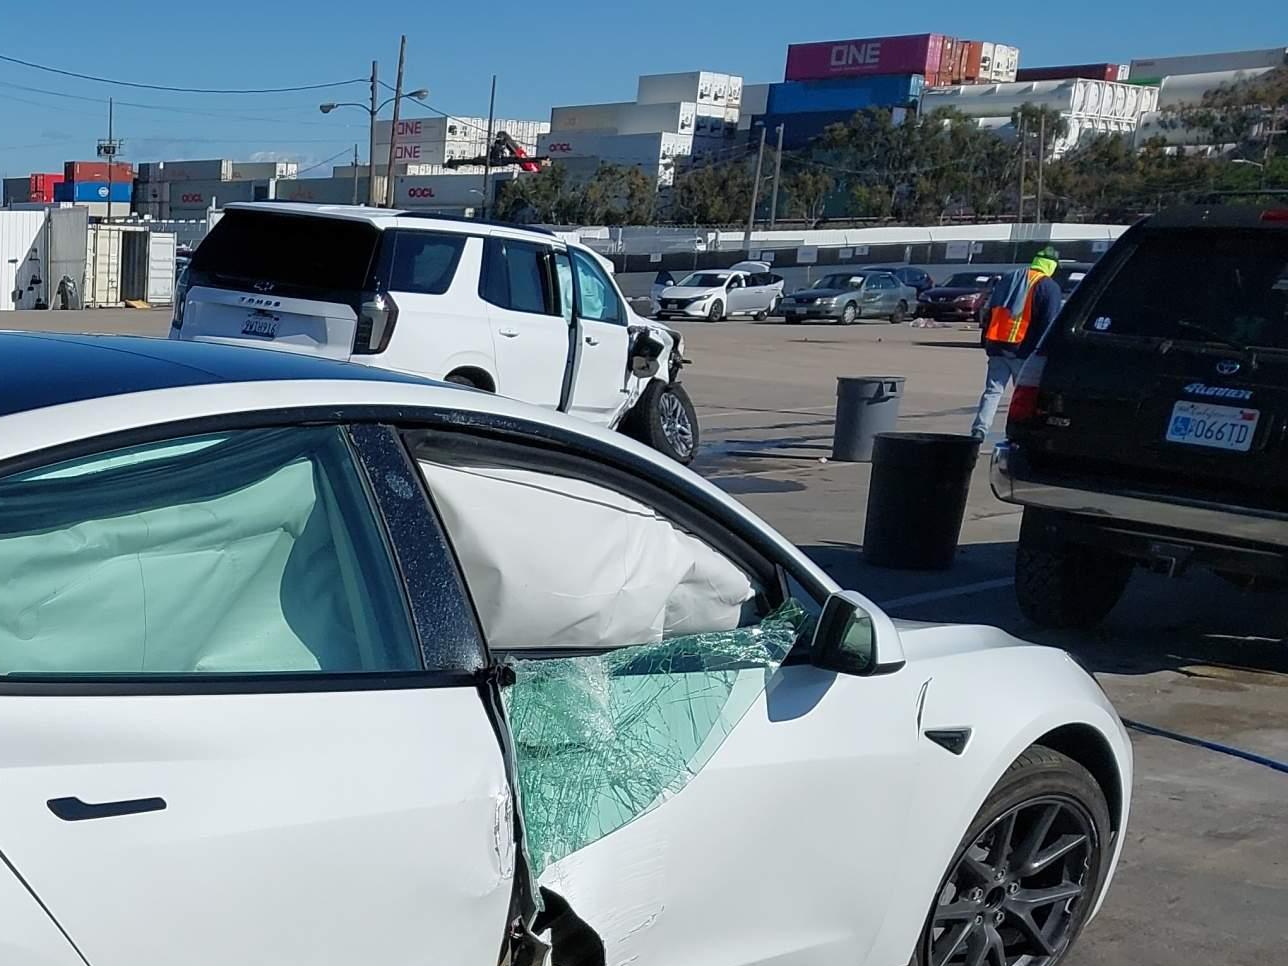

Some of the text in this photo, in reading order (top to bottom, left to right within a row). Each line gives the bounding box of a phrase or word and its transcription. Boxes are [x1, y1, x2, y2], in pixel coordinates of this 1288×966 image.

[830, 43, 881, 66] ONE
[408, 187, 435, 198] OOCL
[240, 296, 281, 307] TAHOE
[1194, 419, 1249, 444] 066TD
